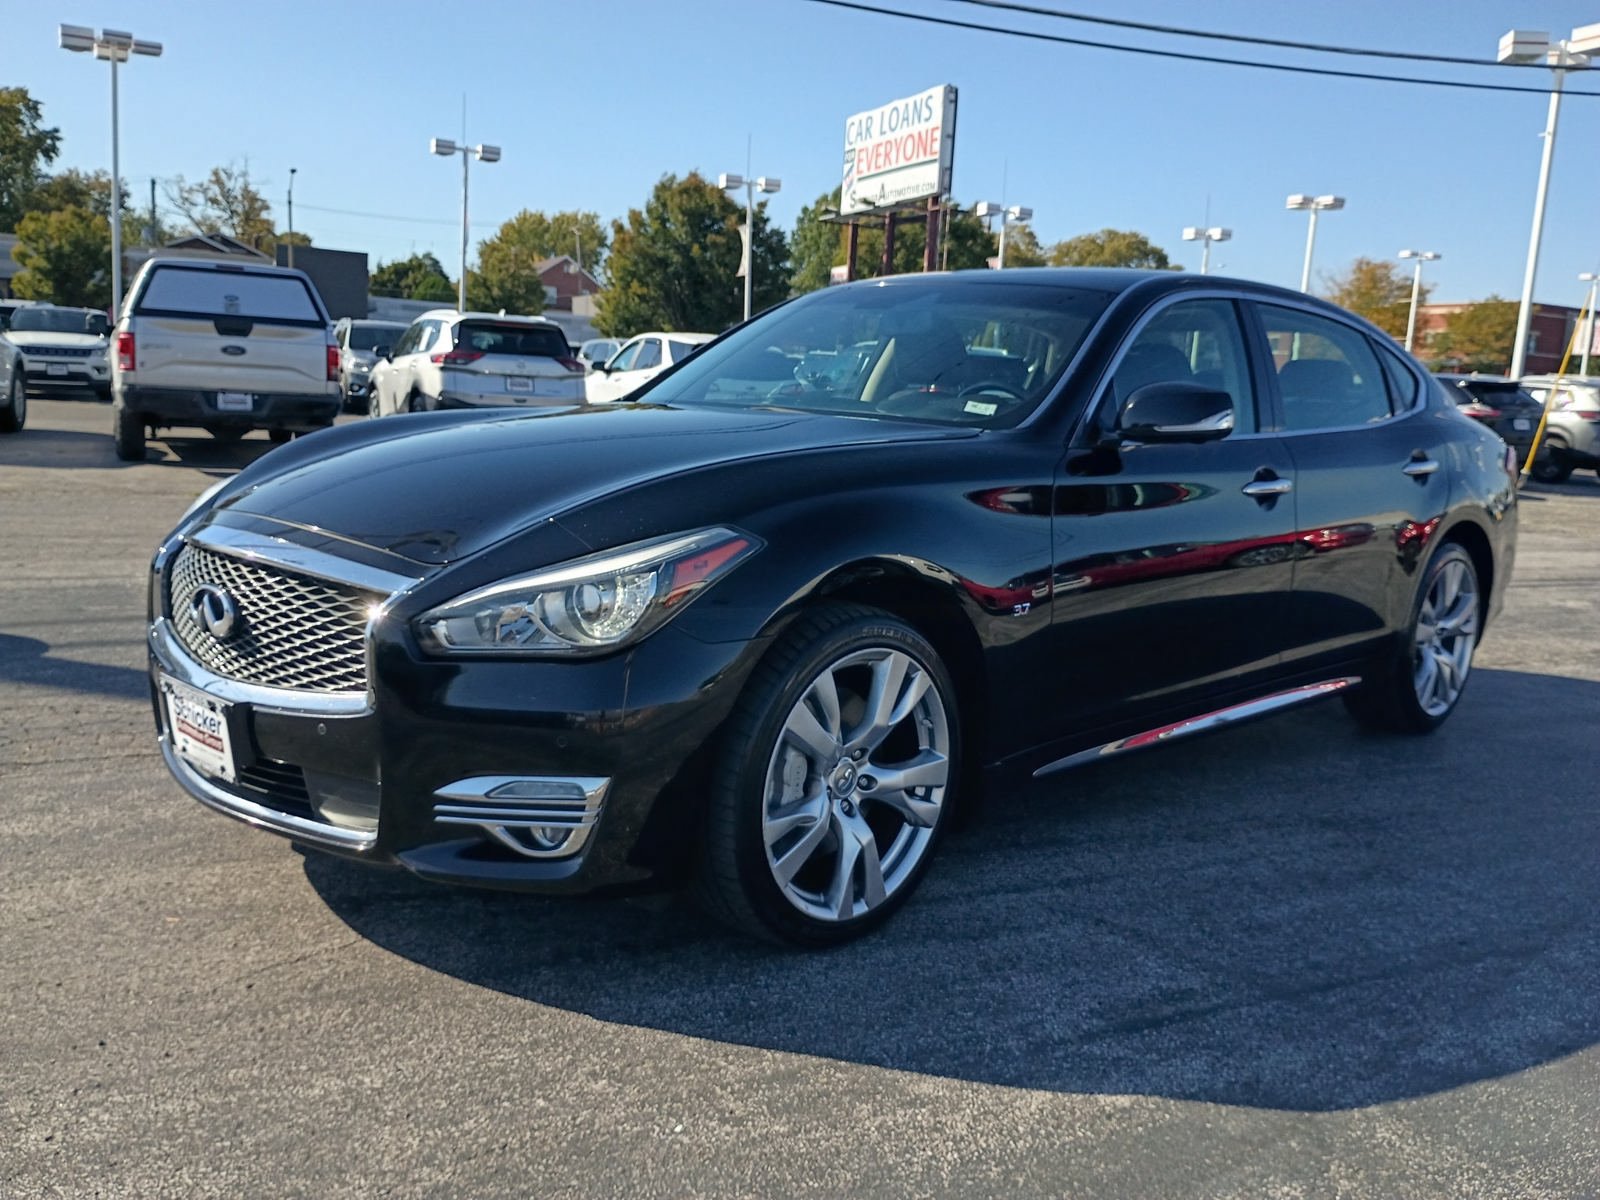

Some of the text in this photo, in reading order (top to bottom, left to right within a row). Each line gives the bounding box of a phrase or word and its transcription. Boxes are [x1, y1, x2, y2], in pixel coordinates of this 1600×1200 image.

[847, 95, 933, 145] CAR LOANS
[856, 126, 940, 175] EVERYONE
